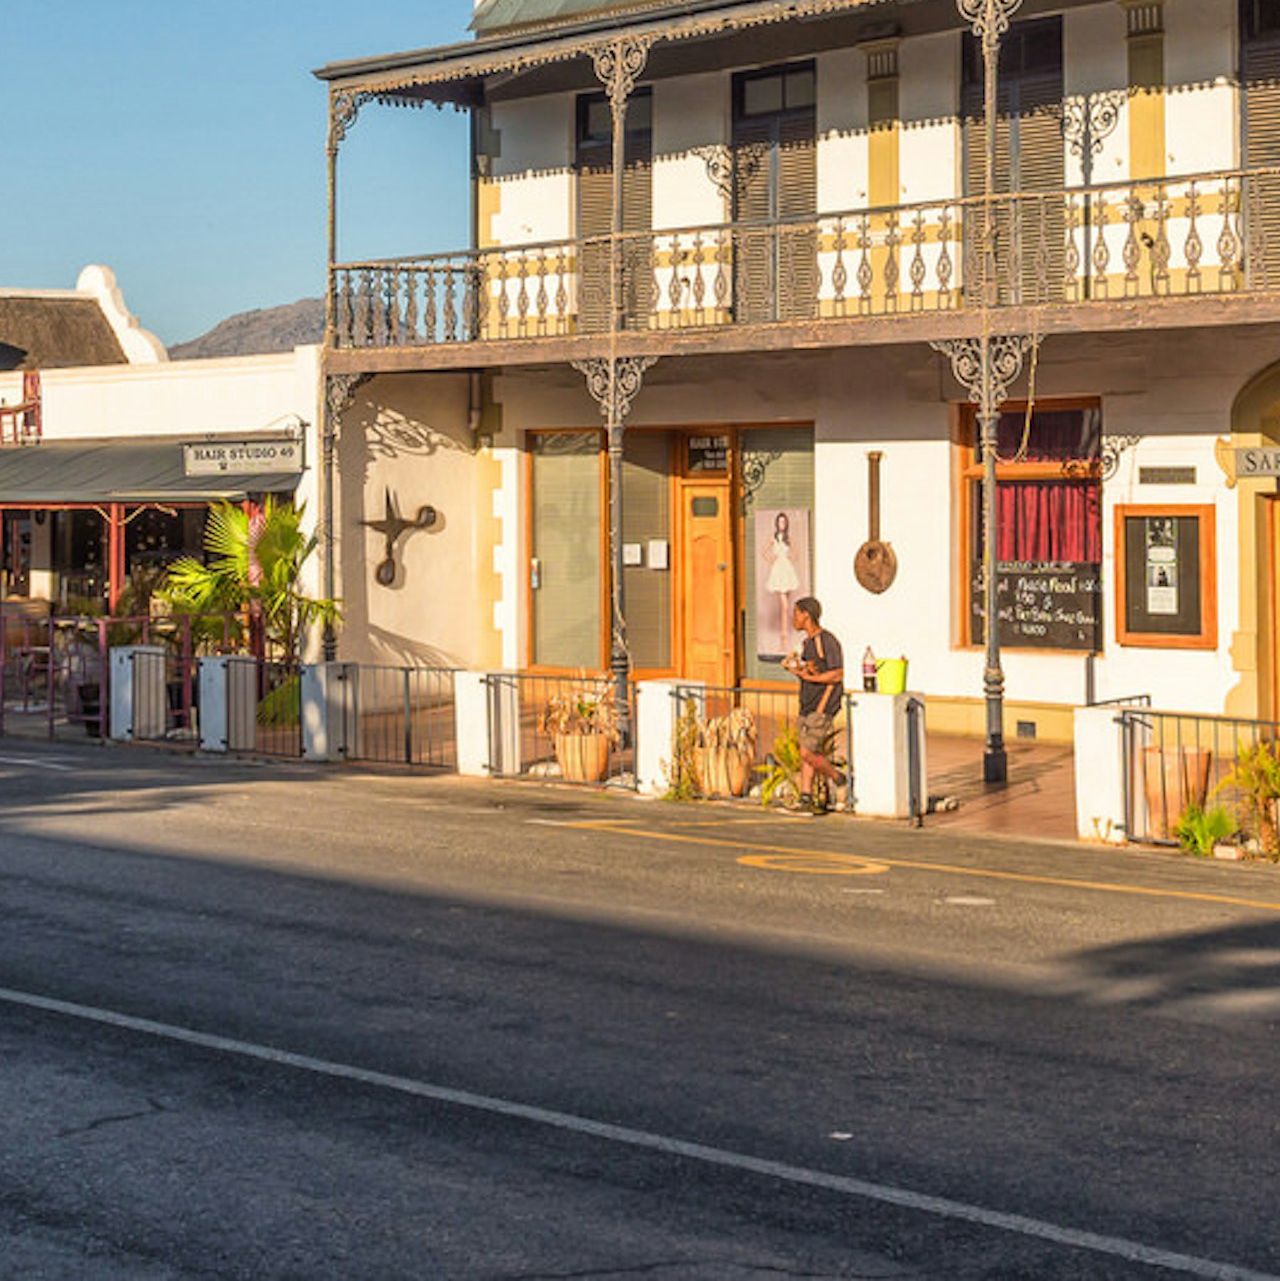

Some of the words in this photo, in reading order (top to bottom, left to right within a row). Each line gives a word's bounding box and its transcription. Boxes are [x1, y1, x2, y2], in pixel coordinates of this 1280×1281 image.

[194, 448, 226, 460] HAIR
[229, 446, 278, 460] STUDIO
[280, 446, 294, 457] 49
